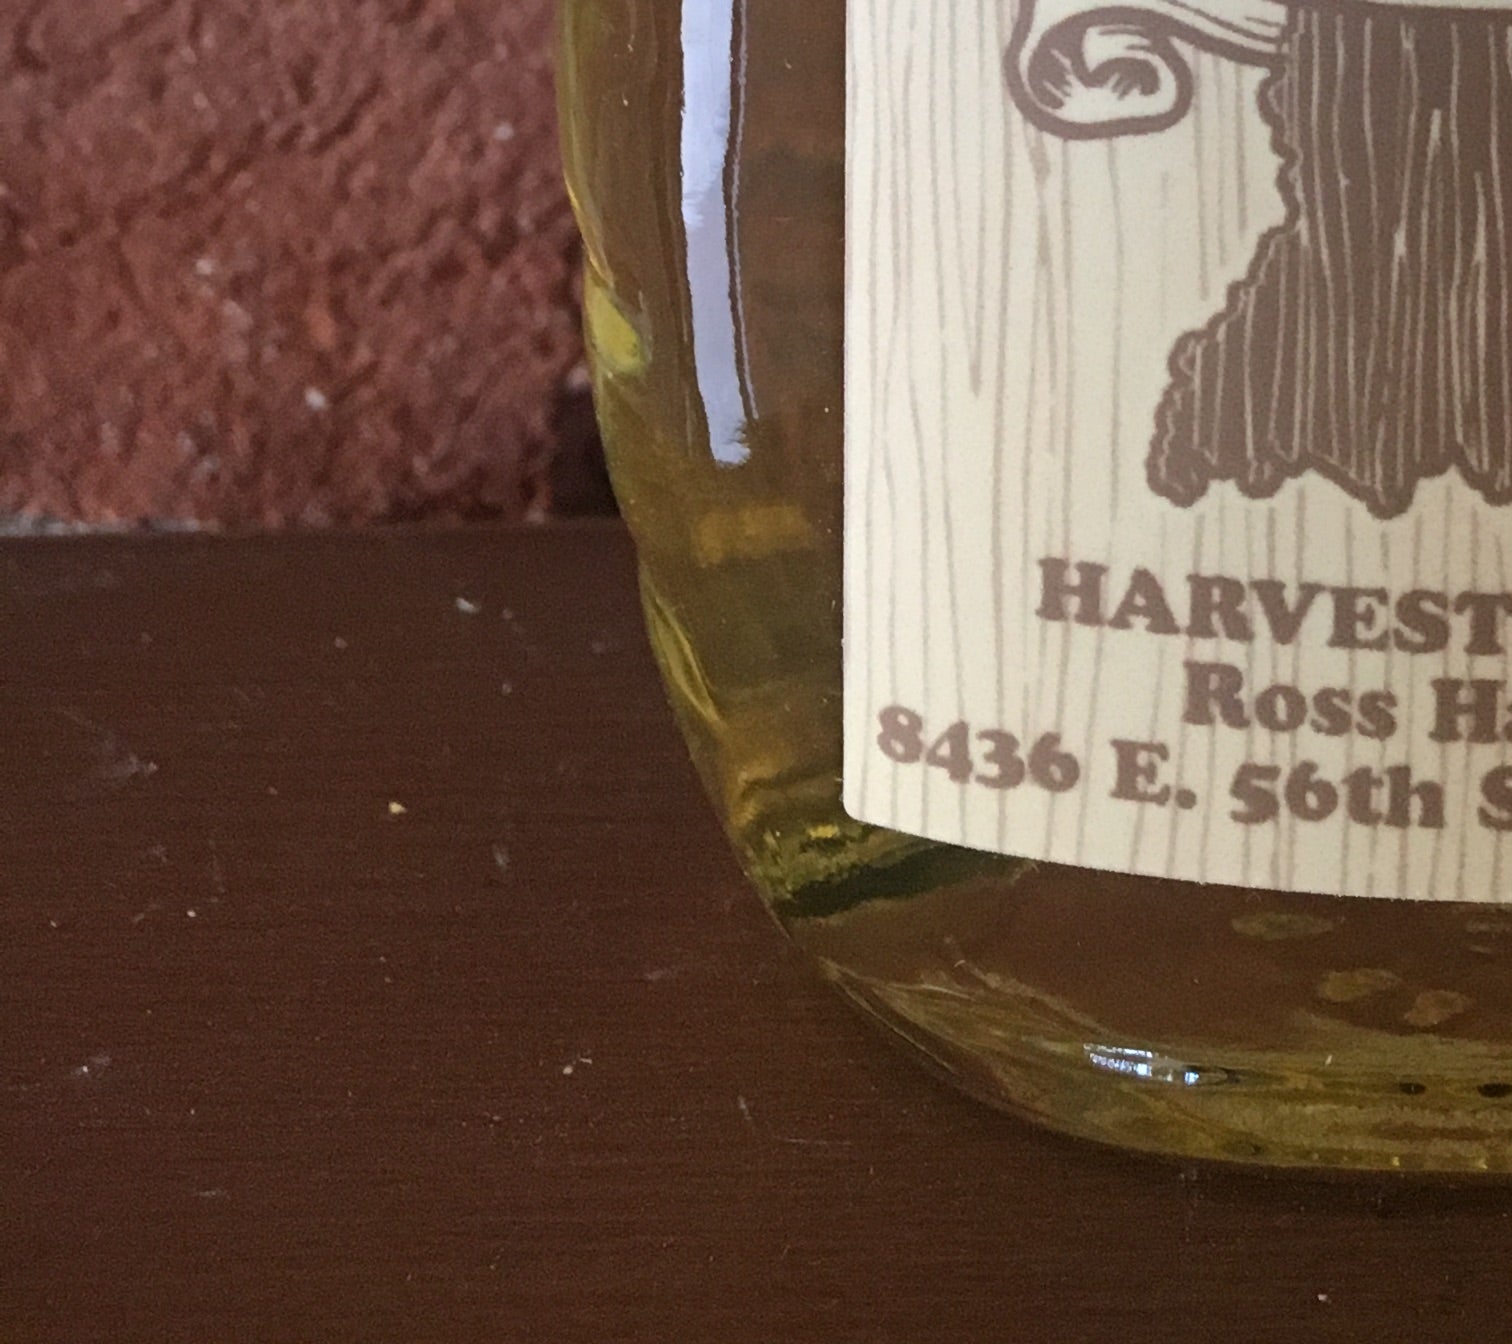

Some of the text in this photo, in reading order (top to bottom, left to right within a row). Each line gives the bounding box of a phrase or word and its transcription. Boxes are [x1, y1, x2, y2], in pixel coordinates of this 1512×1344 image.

[1181, 659, 1399, 740] Ross
[876, 704, 1081, 793] 8436
[1109, 738, 1198, 810] E.
[1230, 760, 1446, 830] 56th
